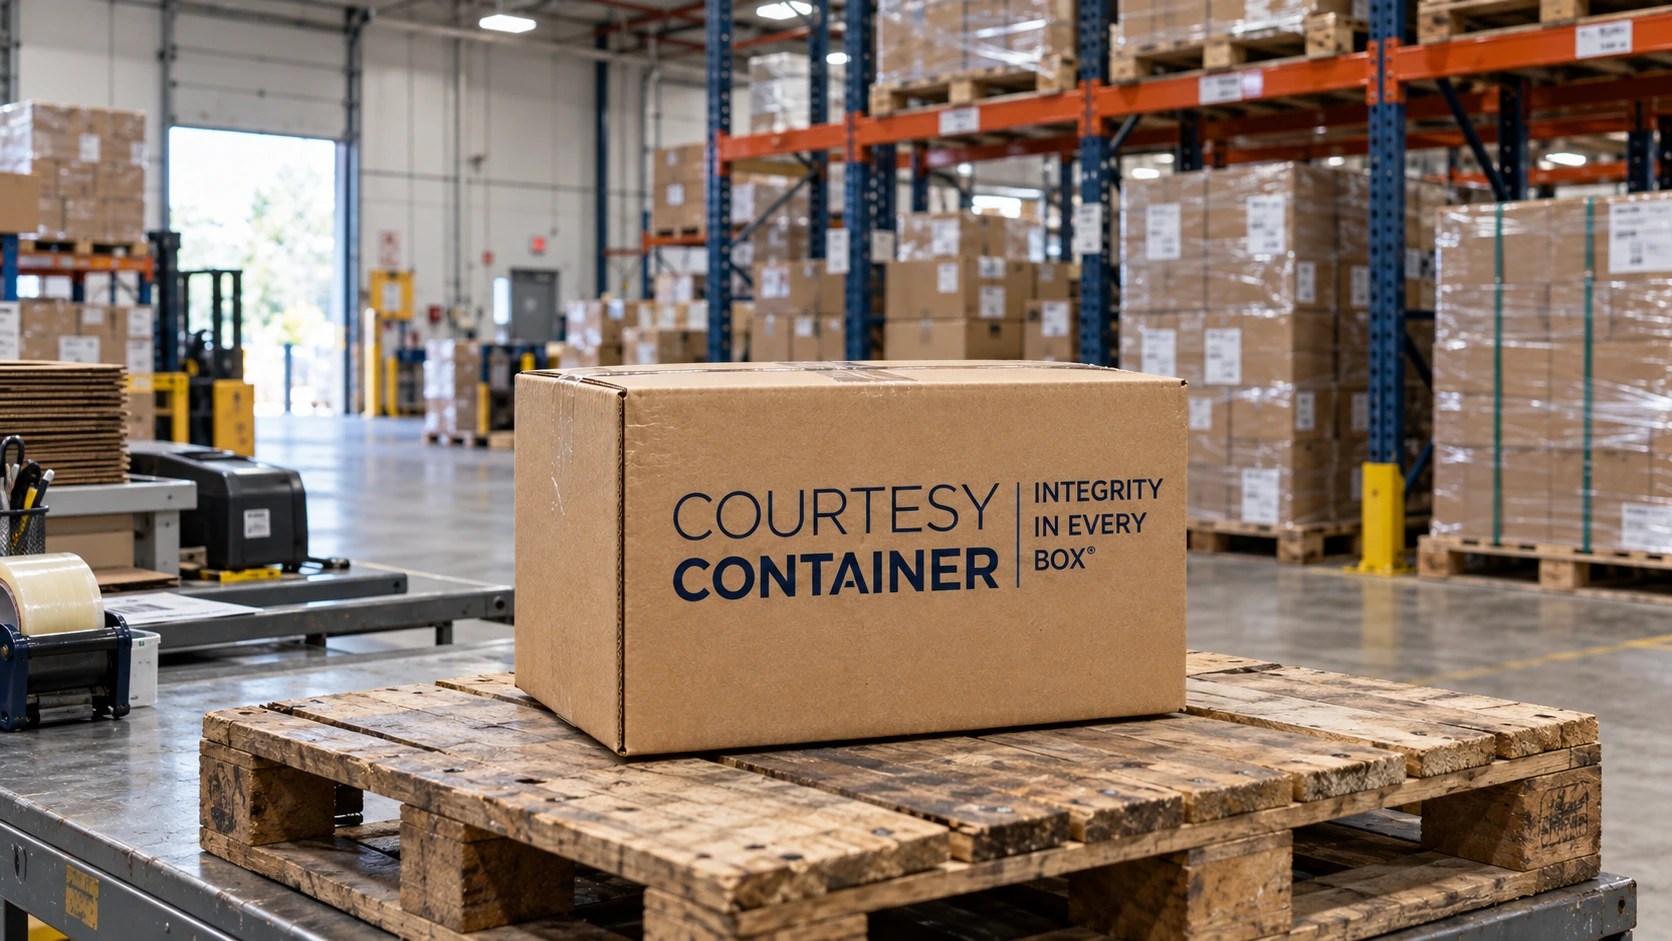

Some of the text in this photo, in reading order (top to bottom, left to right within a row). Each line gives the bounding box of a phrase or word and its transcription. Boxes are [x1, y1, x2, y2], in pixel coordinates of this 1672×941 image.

[1034, 477, 1164, 504] INTEGRITY
[672, 482, 1000, 542] COURTESY
[1034, 511, 1147, 538] IN EVERY
[672, 546, 1000, 603] CONTAINER
